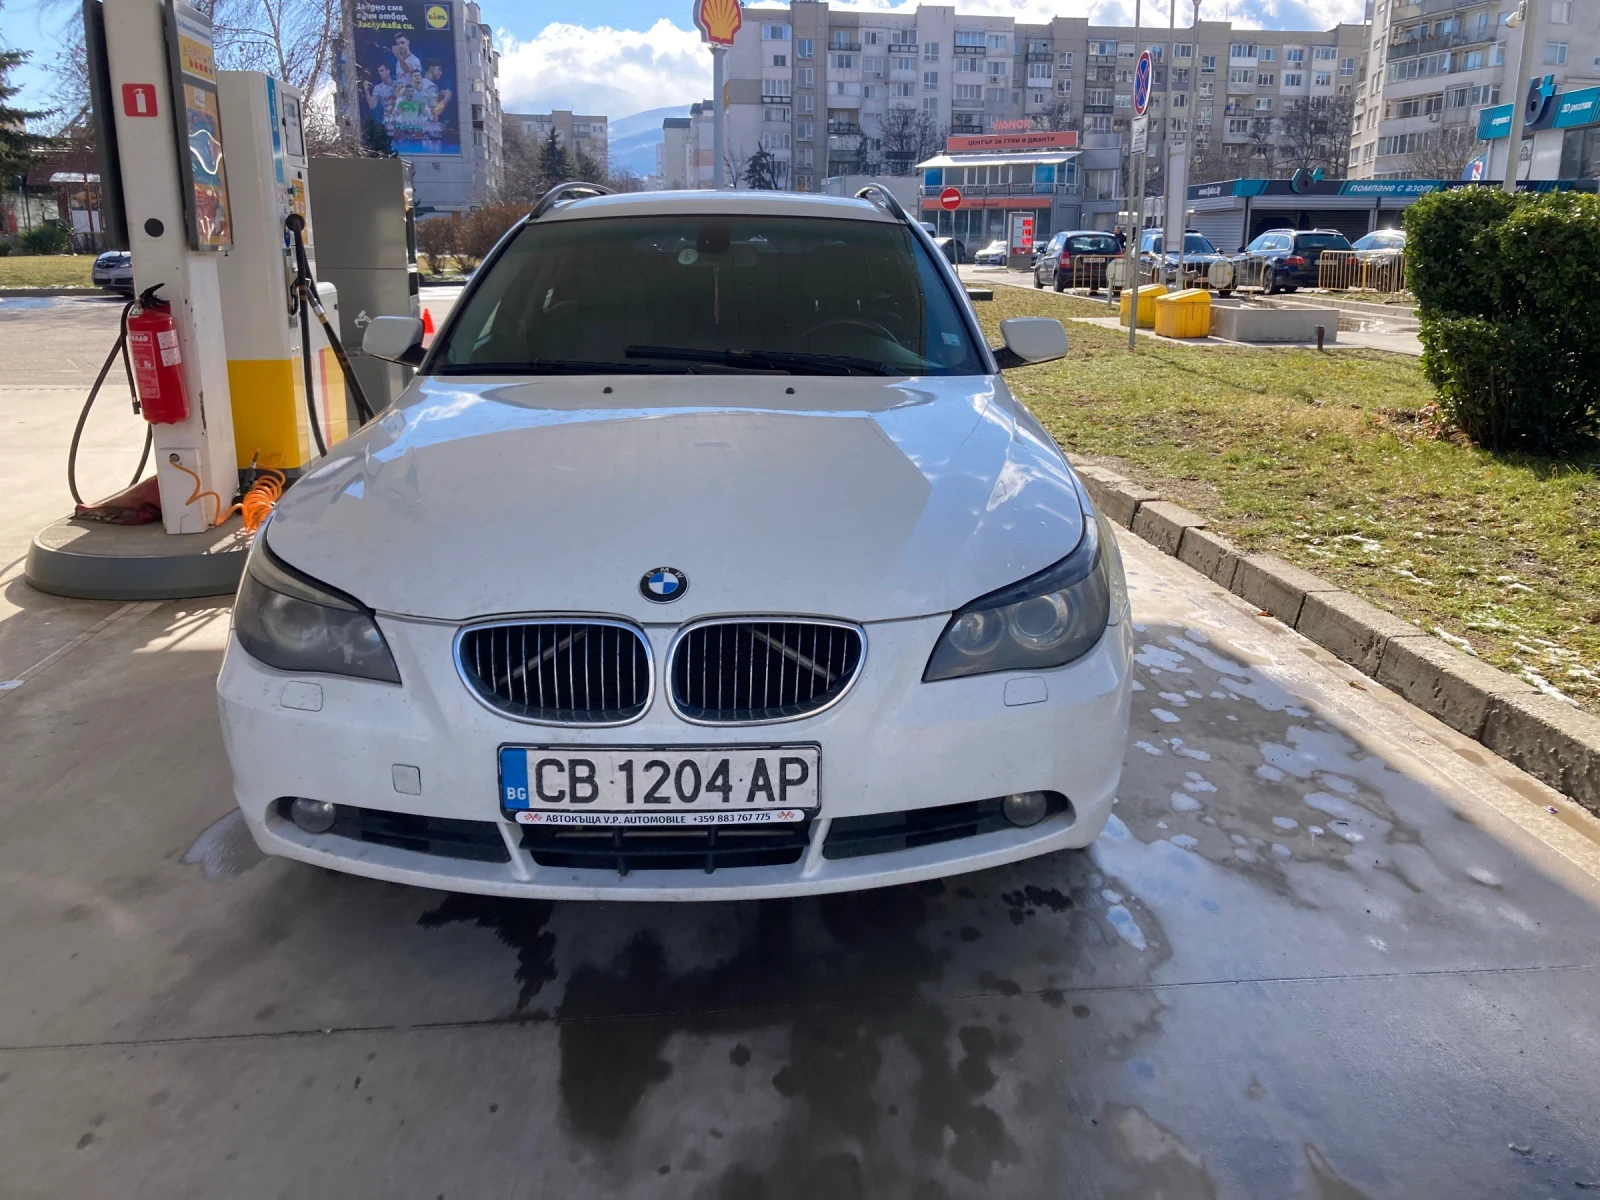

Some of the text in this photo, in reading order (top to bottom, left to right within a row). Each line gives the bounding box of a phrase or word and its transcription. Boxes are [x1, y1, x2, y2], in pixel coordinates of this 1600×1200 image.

[378, 12, 408, 22] отбор.
[1028, 136, 1055, 144] ДЖАНТИ
[1350, 184, 1396, 192] помпане
[1405, 185, 1434, 193] азот
[645, 567, 684, 578] BMW
[506, 757, 809, 804] BG CB 1204 AP
[545, 814, 601, 824] АВТОКЪЩА
[603, 815, 622, 824] V.P.
[623, 815, 686, 824] AUTOMOBILE
[693, 814, 715, 823] +359
[717, 814, 735, 823] 883
[737, 813, 753, 822] 767
